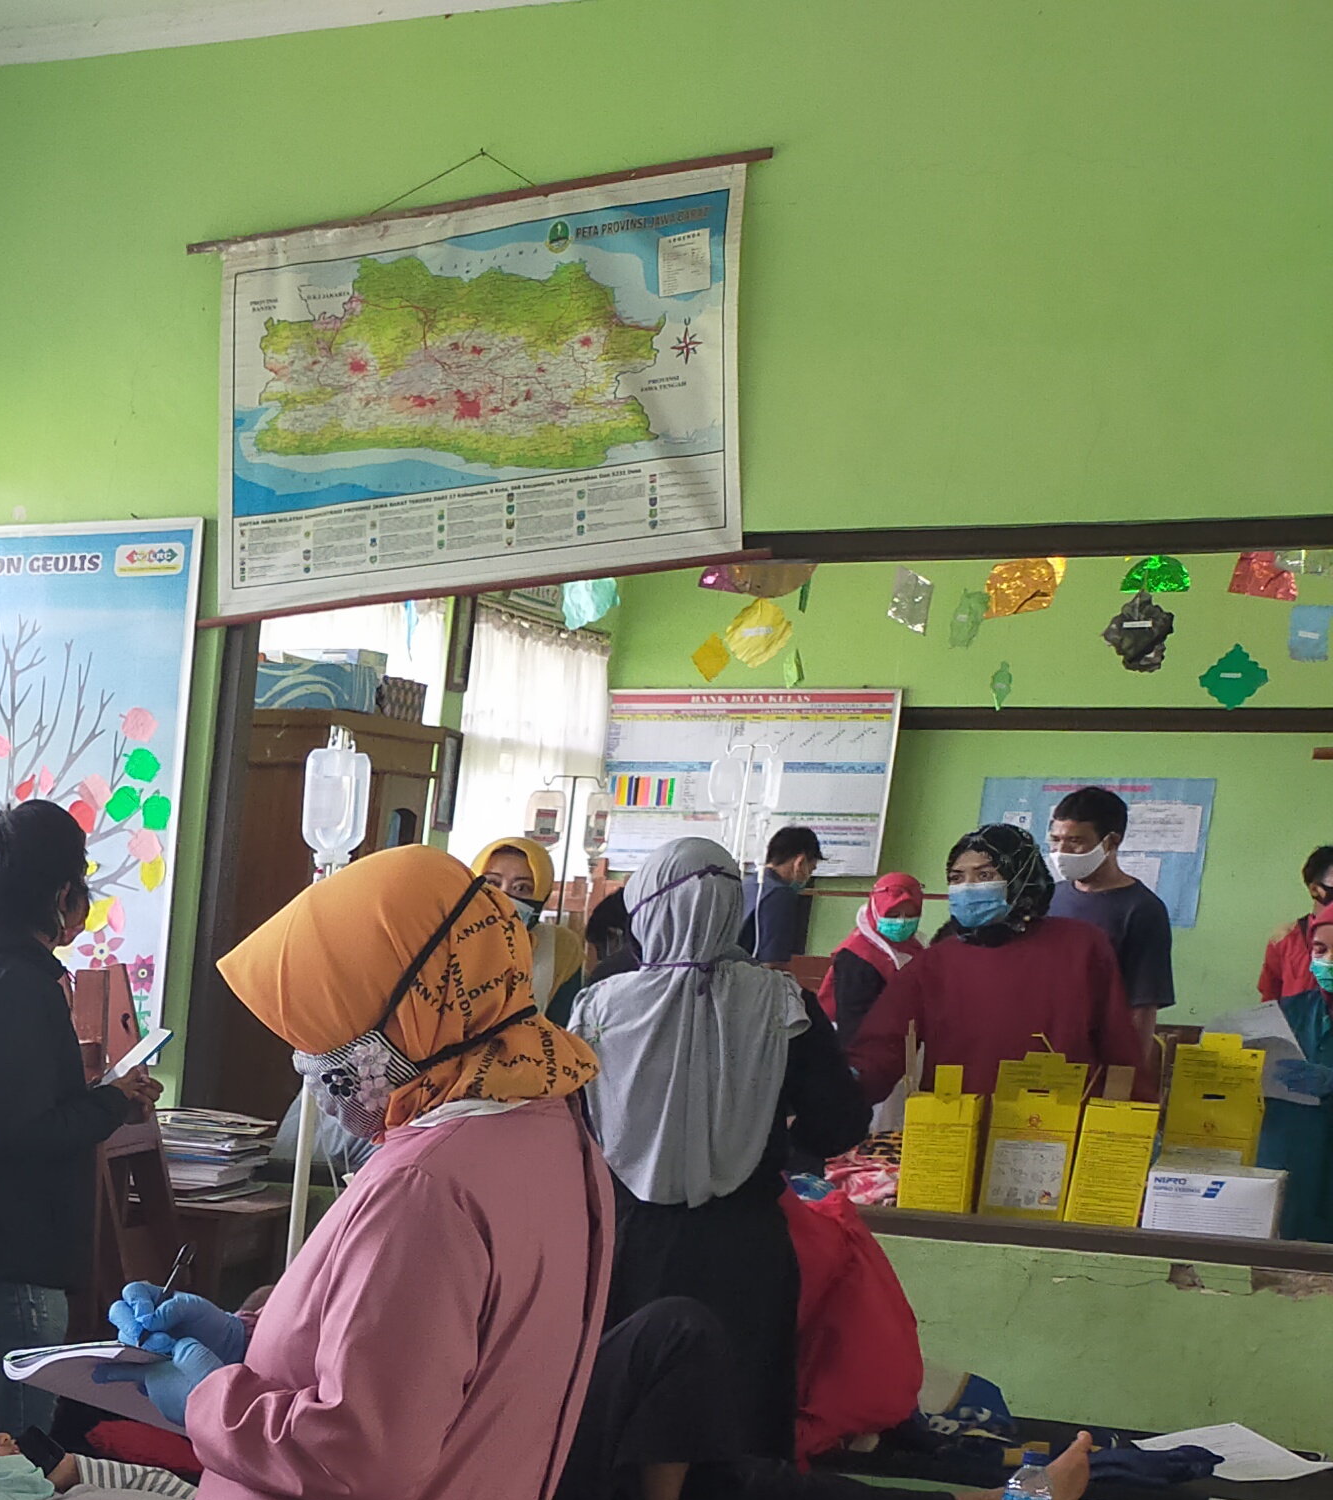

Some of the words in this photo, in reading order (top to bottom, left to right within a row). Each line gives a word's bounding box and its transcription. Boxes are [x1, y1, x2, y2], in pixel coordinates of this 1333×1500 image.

[575, 225, 599, 239] PETA
[601, 217, 647, 234] PROVINSI
[649, 213, 675, 229] JAWA
[28, 553, 102, 574] GEULIS
[1153, 1176, 1188, 1186] NIPRO
